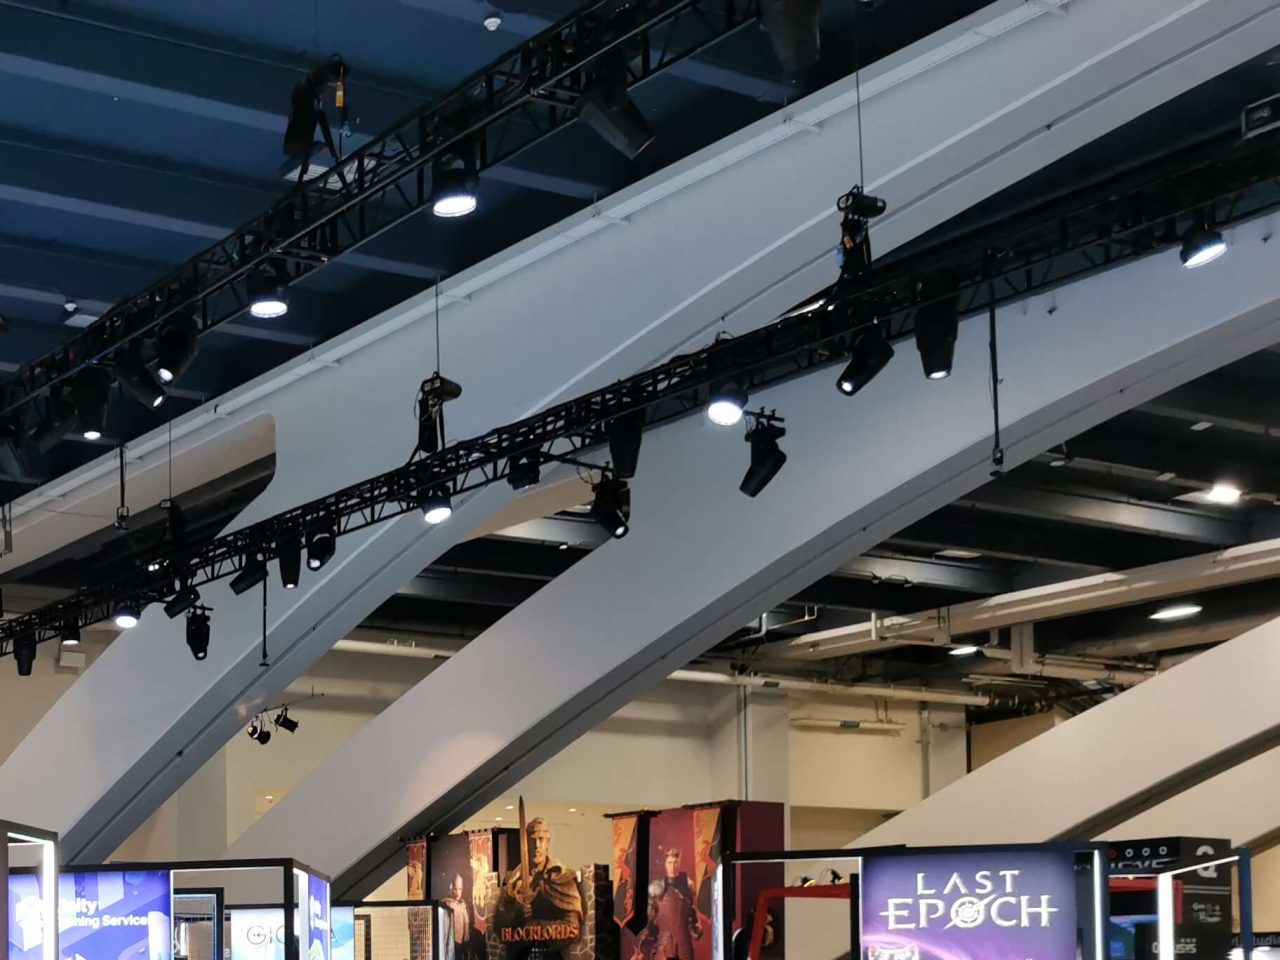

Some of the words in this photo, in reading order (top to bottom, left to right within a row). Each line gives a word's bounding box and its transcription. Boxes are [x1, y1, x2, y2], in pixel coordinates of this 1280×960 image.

[917, 870, 1020, 895] LAST
[880, 895, 1058, 930] EPOCH
[501, 923, 579, 942] BLOCKLORDS
